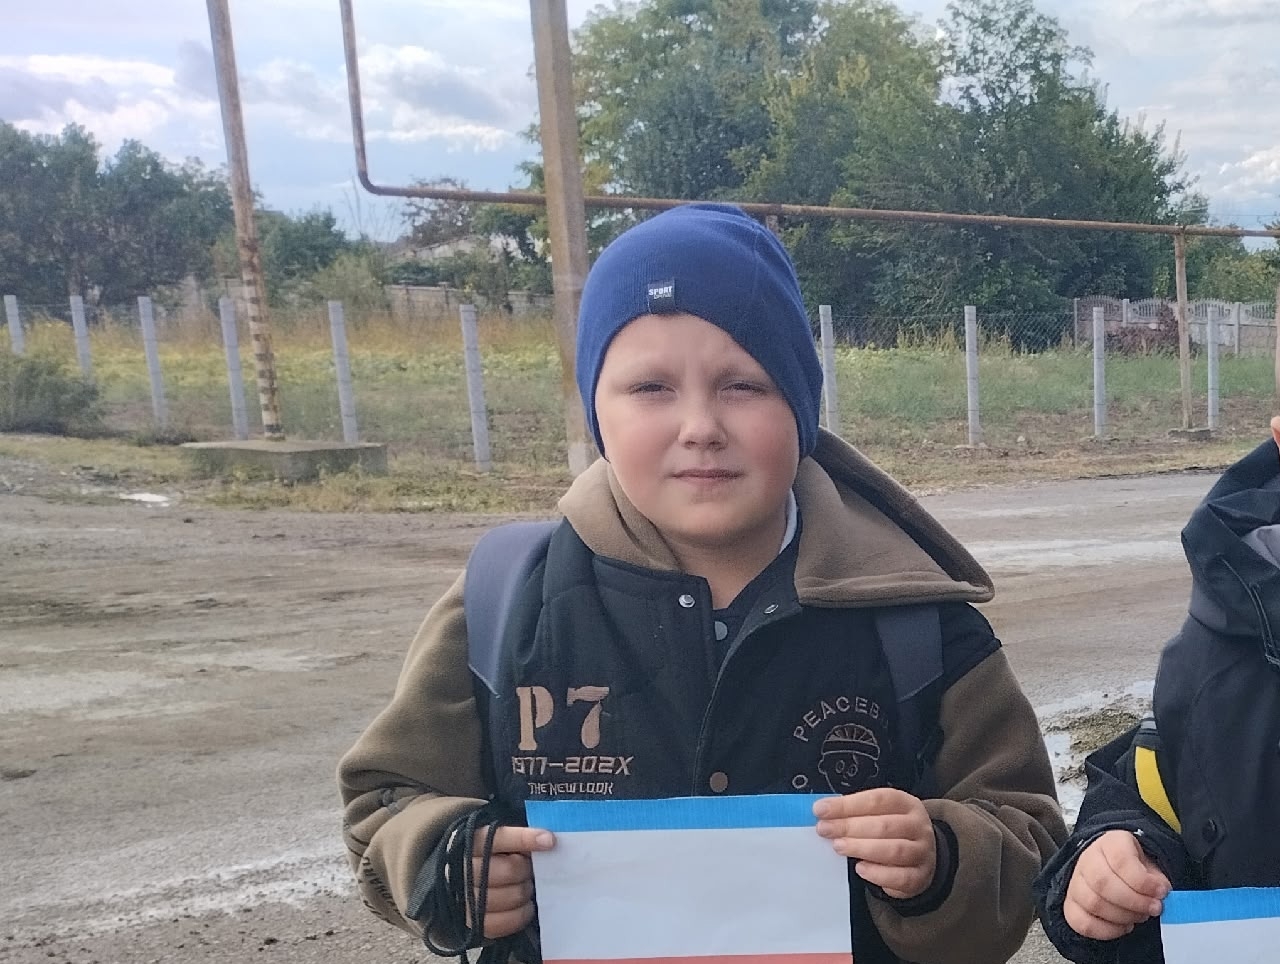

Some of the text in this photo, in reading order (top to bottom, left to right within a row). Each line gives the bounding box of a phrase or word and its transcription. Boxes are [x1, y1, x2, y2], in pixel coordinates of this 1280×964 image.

[649, 286, 673, 296] SPORT
[528, 782, 614, 796] THE NEW LOOK
